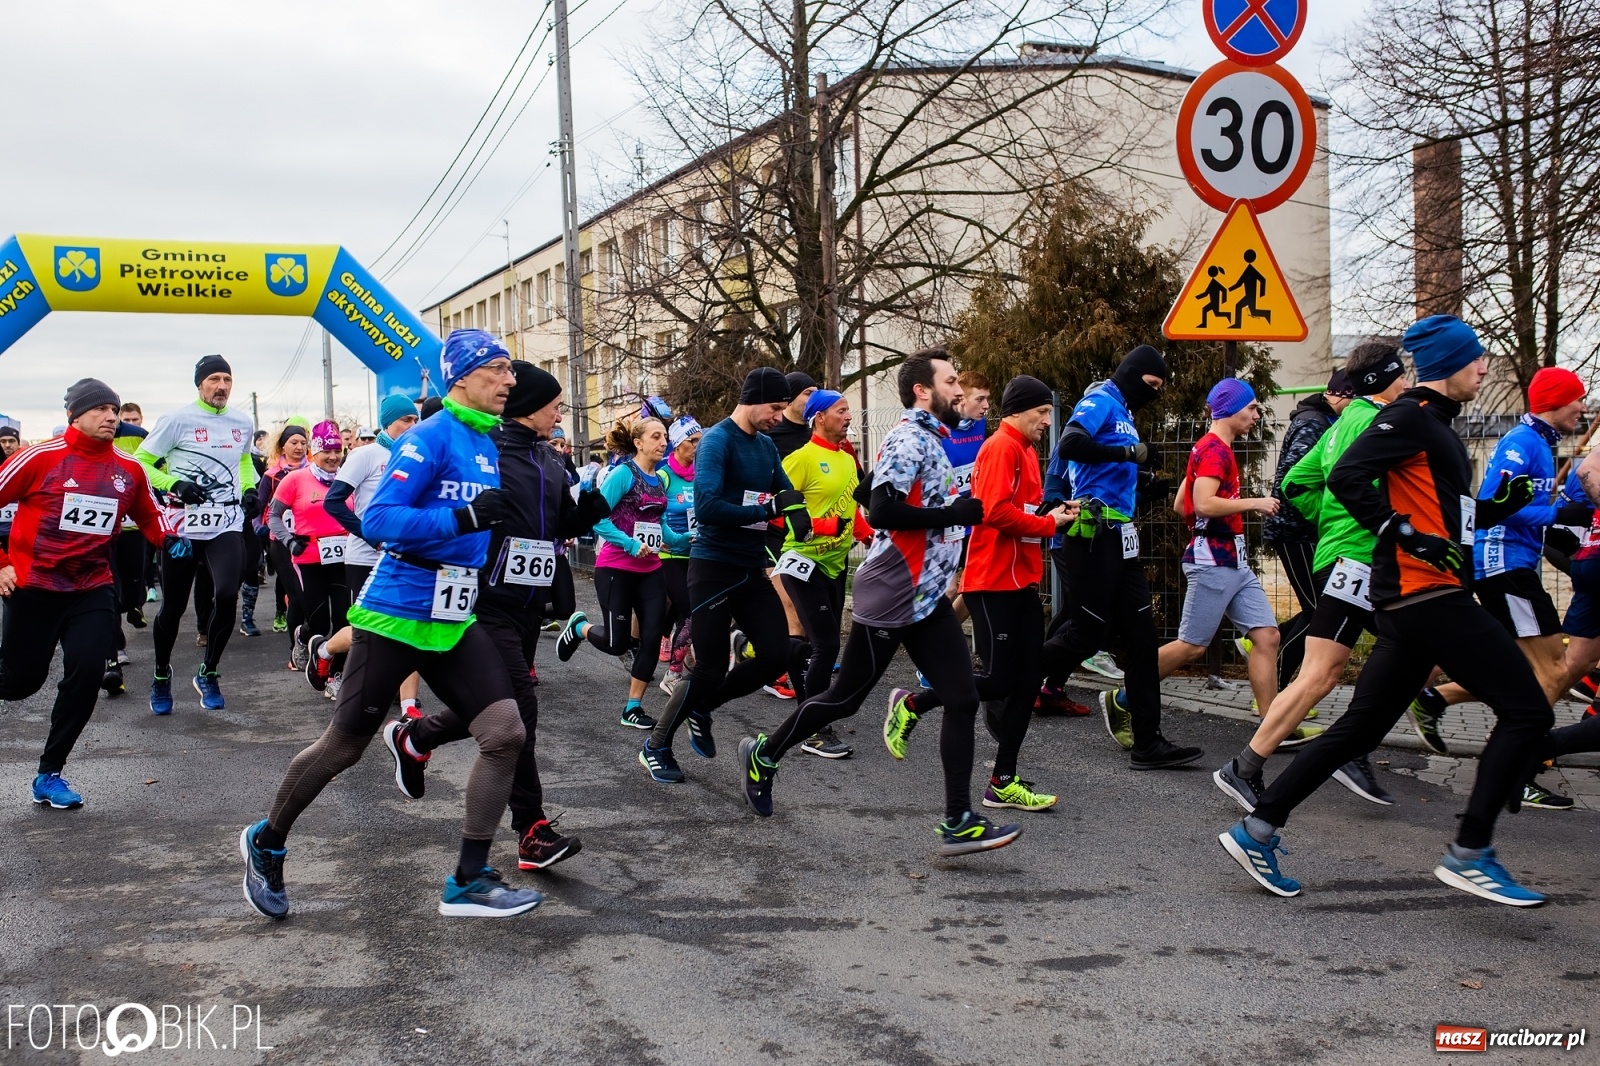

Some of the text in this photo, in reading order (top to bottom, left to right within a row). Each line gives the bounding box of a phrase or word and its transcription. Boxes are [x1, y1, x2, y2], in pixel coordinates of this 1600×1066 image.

[1200, 96, 1294, 175] 30
[141, 248, 227, 263] Gmina
[119, 263, 249, 281] Pietrowice
[136, 282, 233, 299] Wielkie
[340, 271, 421, 348] Gmina ludzi
[327, 289, 404, 361] aktywnych
[952, 434, 984, 446] RUNNING
[63, 507, 114, 529] 427
[187, 513, 222, 527] 287
[636, 532, 662, 548] 308
[321, 545, 347, 560] 29
[510, 554, 554, 578] 366
[440, 585, 477, 611] 150
